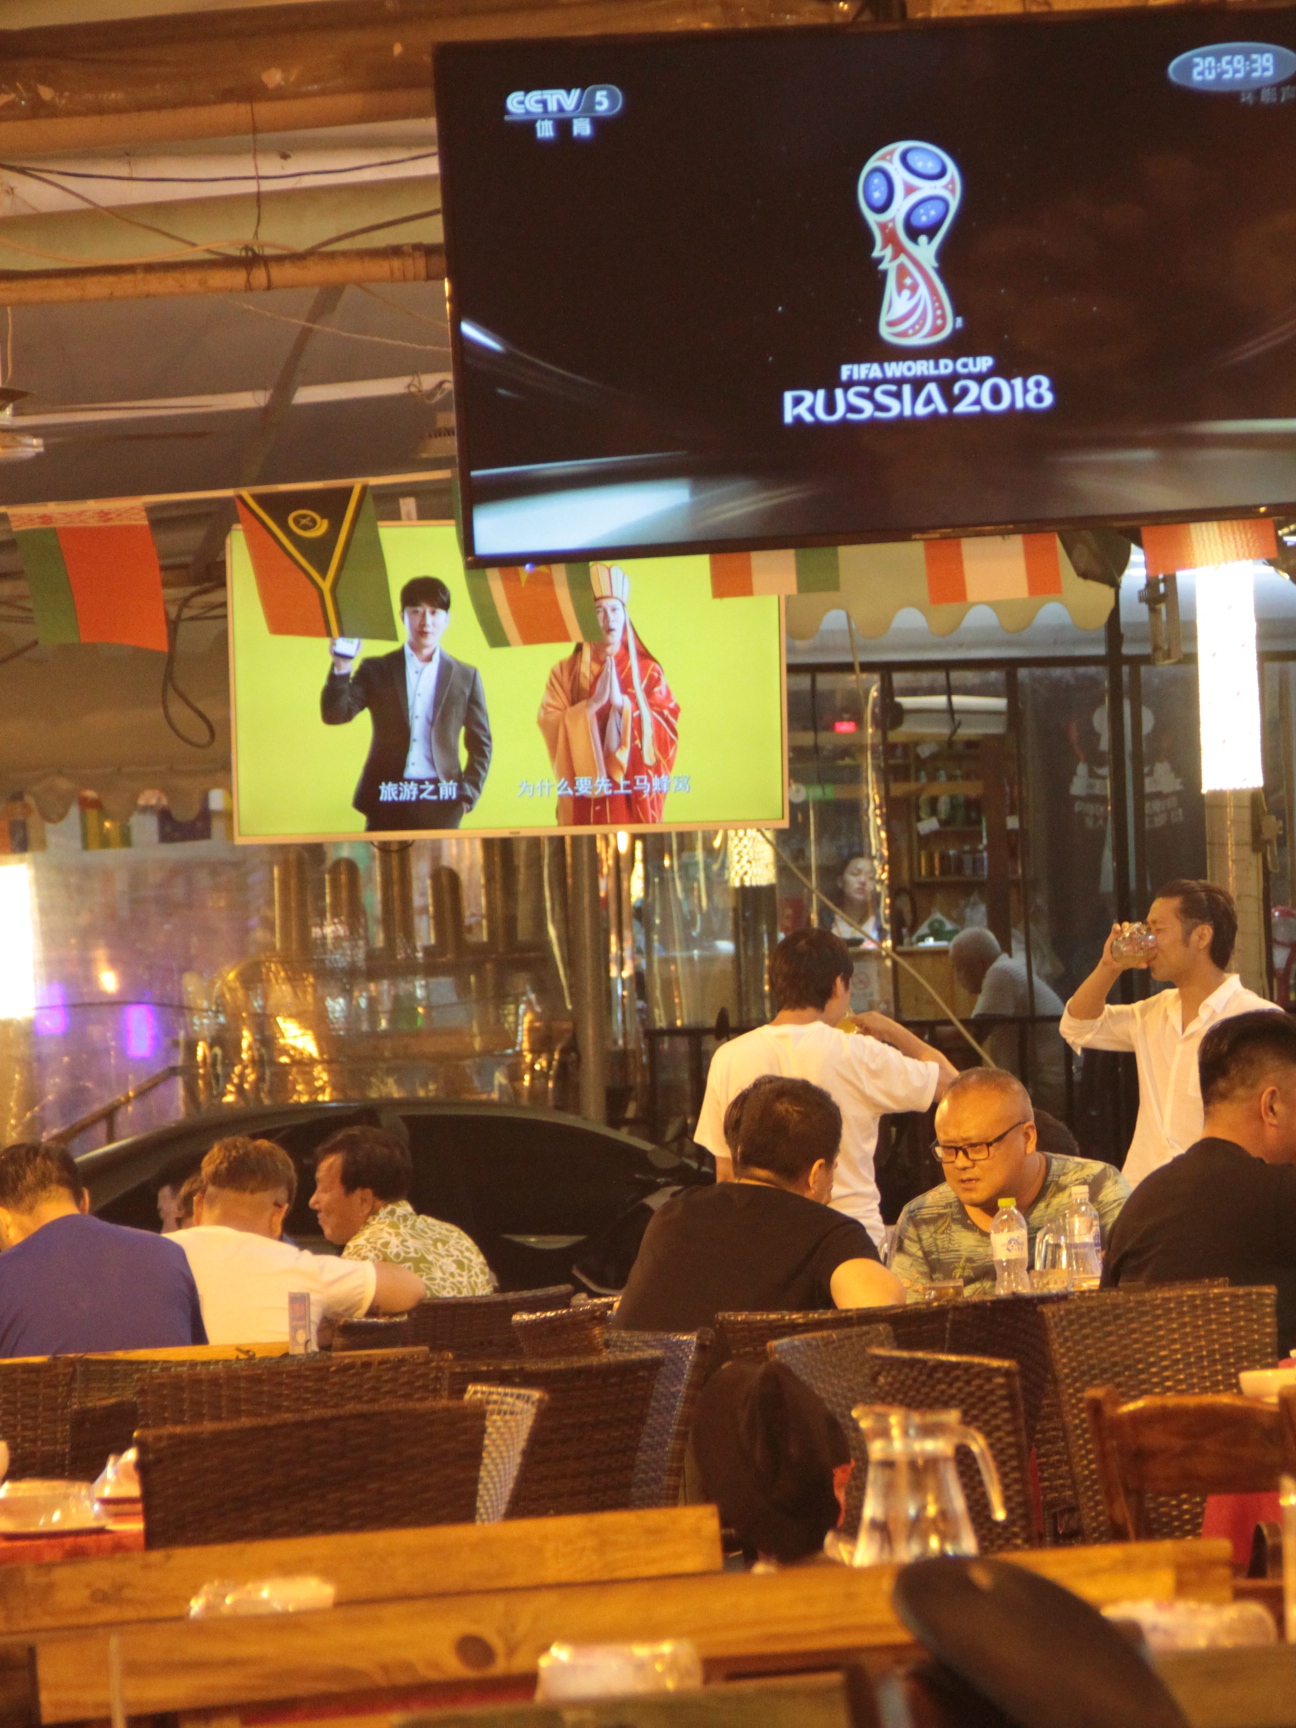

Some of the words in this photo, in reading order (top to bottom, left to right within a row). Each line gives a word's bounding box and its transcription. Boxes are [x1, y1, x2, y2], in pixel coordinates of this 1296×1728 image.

[1191, 52, 1275, 82] 20:59:39
[505, 87, 581, 114] CCTV
[594, 89, 610, 112] 5
[534, 117, 592, 139] 体育
[840, 361, 883, 382] FIFA
[883, 357, 954, 379] WORLD
[955, 355, 995, 374] CUP
[783, 380, 949, 425] RUSSIA
[952, 374, 1054, 414] 2018
[378, 780, 459, 802] 旅游之前
[516, 774, 693, 798] 为什么要先上马蜂窝
